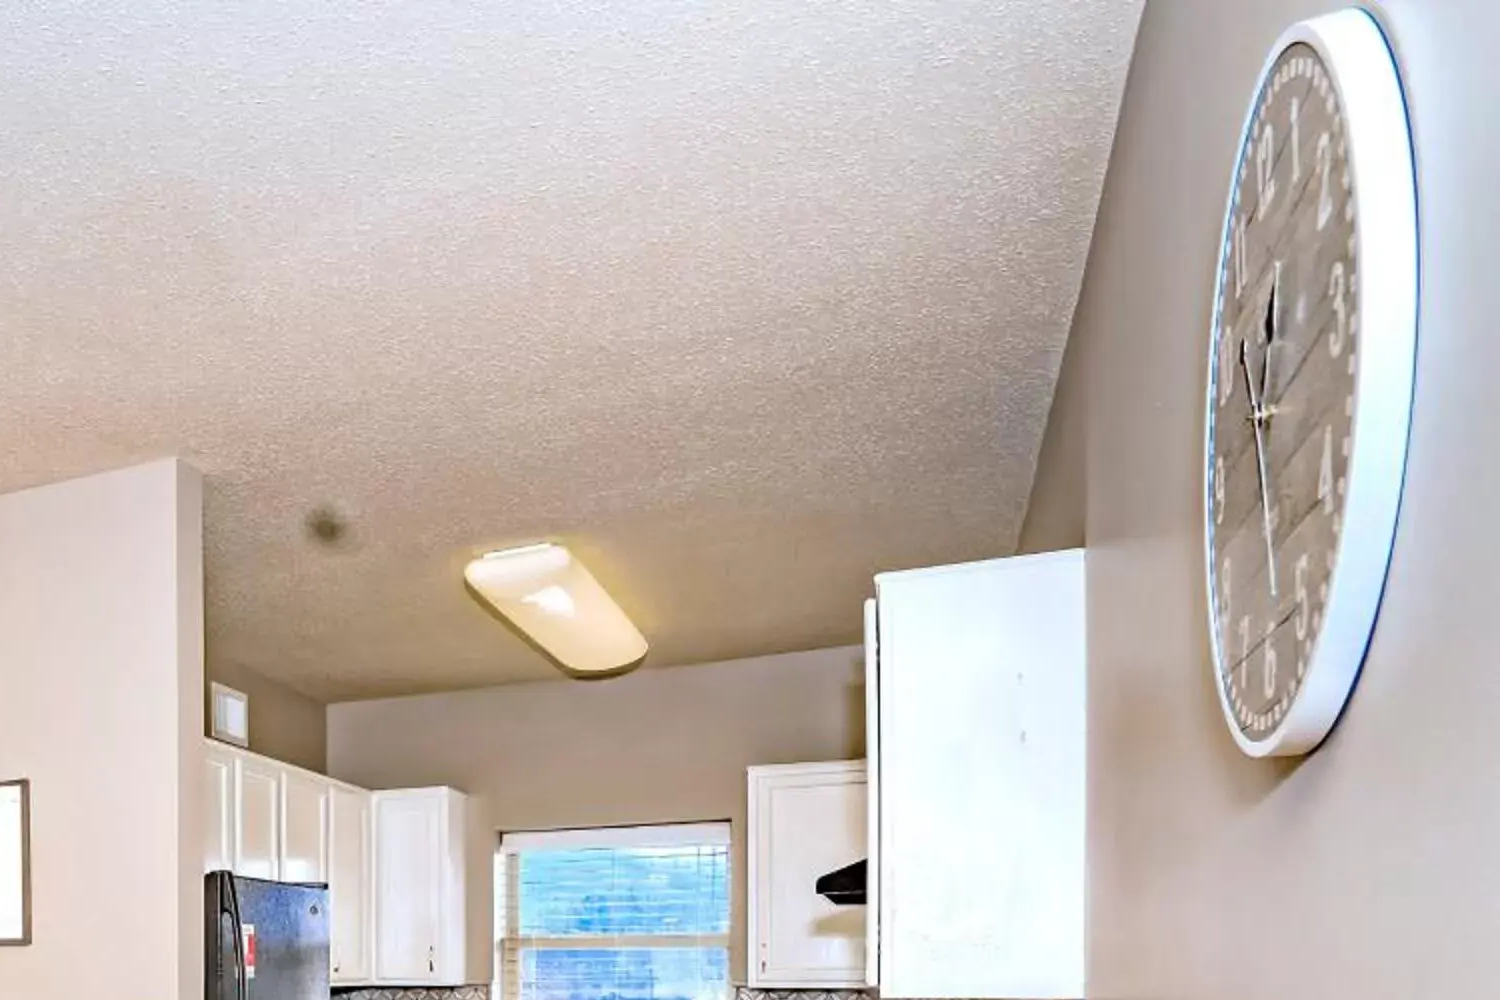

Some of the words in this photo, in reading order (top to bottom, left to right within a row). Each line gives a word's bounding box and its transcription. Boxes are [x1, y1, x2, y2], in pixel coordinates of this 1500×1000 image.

[1315, 132, 1332, 231] 2
[1329, 262, 1344, 358] 3
[1215, 456, 1225, 524] 9
[1317, 424, 1334, 515] 4
[1294, 554, 1308, 640] 5
[1239, 614, 1250, 688] 7
[1264, 621, 1277, 698] 6
